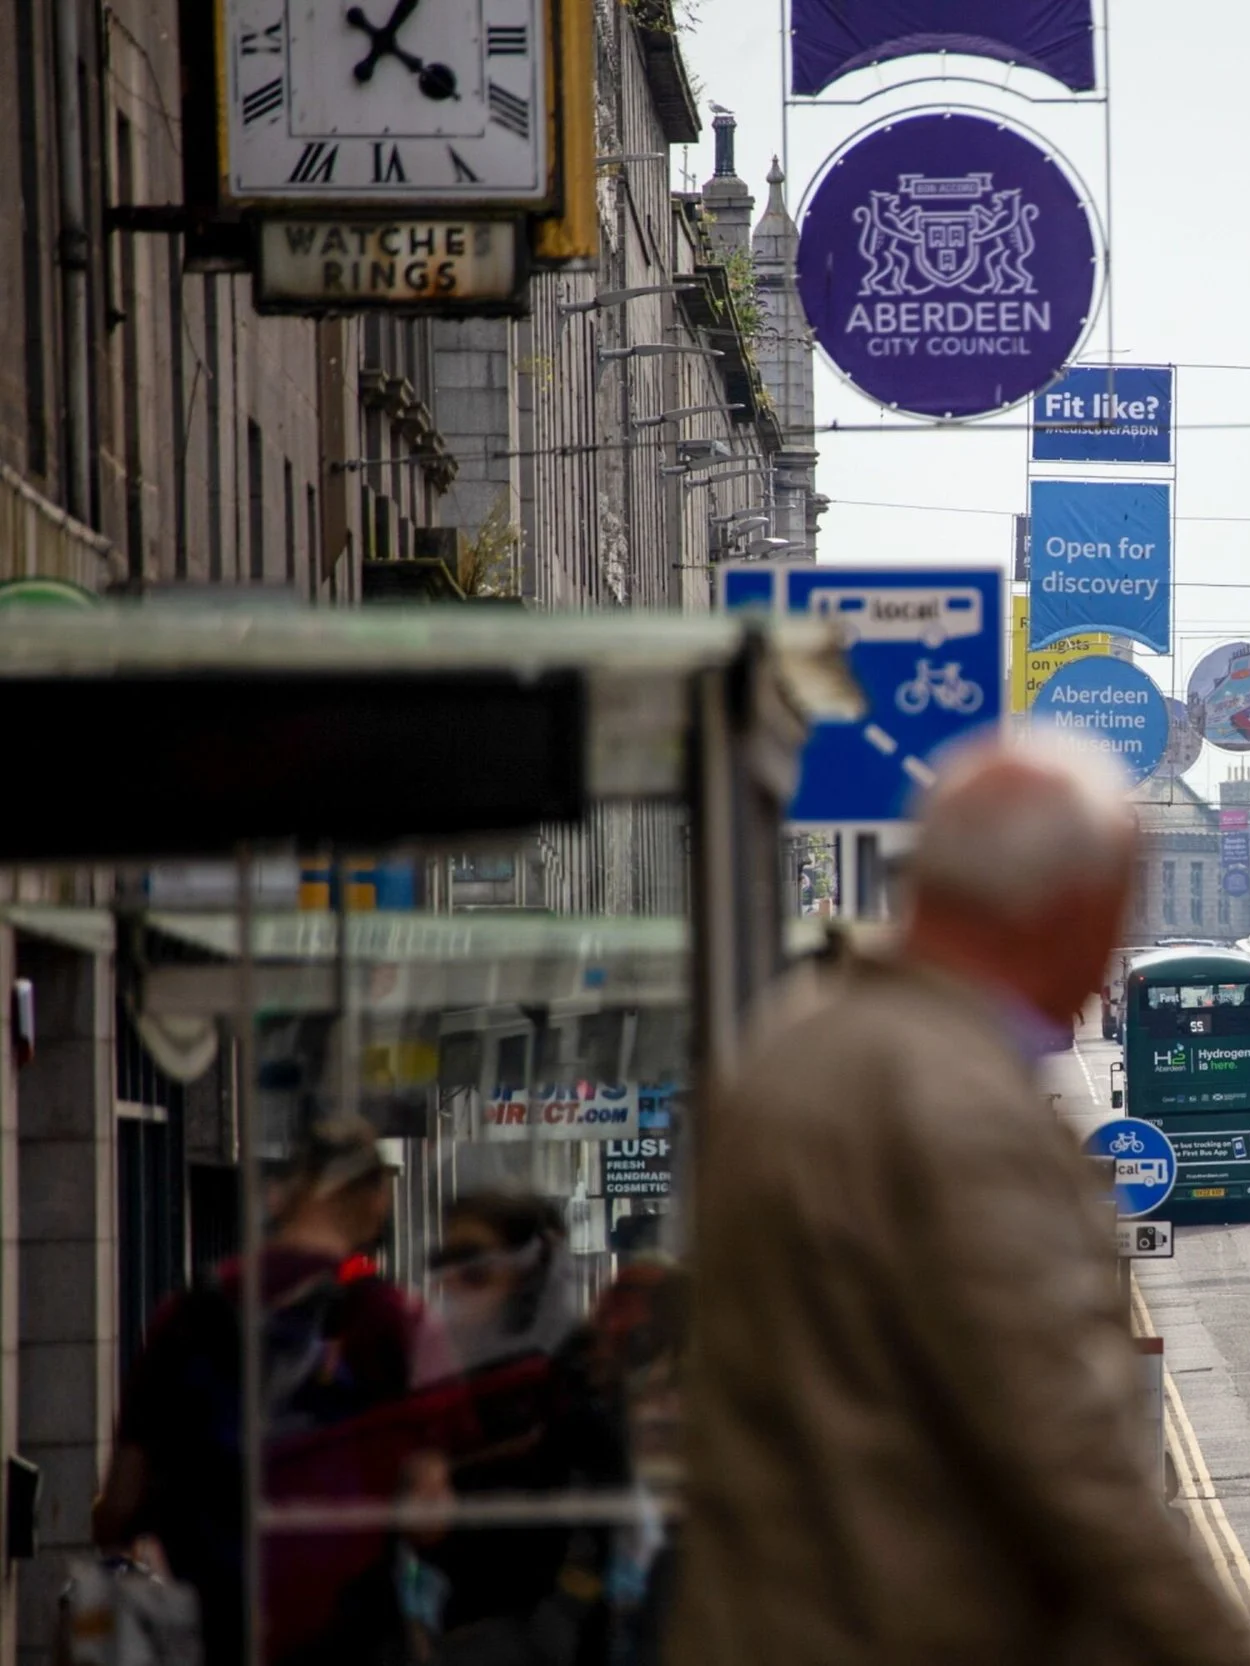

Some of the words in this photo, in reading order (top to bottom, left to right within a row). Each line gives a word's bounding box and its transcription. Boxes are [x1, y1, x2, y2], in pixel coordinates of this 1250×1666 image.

[324, 261, 458, 291] RINGS
[845, 302, 1051, 333] ABERDEEN
[867, 338, 918, 356] CITY
[926, 337, 1031, 356] COUNCIL
[1045, 392, 1085, 418] Fit
[1093, 393, 1160, 421] like?
[1046, 537, 1111, 563] Open
[1118, 537, 1155, 560] for
[1042, 571, 1159, 600] discovery
[1031, 660, 1050, 671] on
[1051, 685, 1148, 704] Aberdeen
[1055, 711, 1146, 729] Maritime
[1198, 1048, 1250, 1060] Hydrogen
[1199, 1061, 1208, 1070] is
[1211, 1060, 1238, 1070] here.
[607, 1161, 645, 1170] FRESH
[1118, 1163, 1139, 1175] cal
[606, 1183, 668, 1193] COSMETIC
